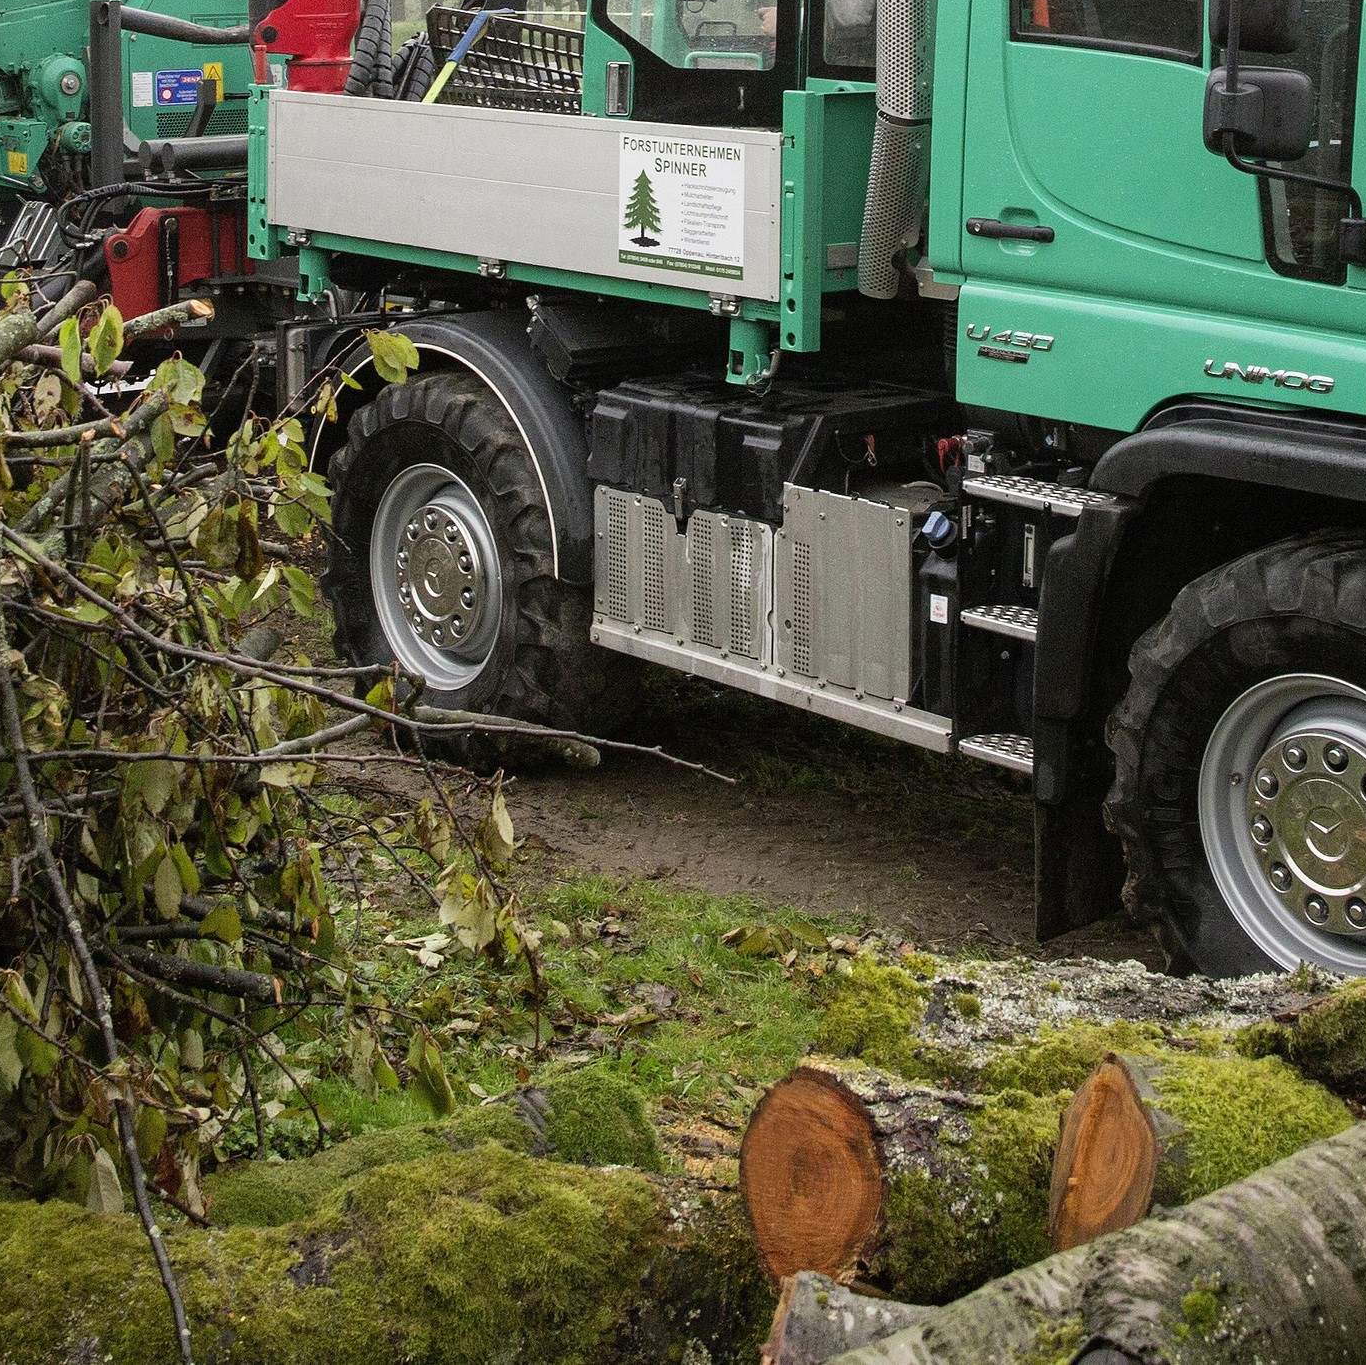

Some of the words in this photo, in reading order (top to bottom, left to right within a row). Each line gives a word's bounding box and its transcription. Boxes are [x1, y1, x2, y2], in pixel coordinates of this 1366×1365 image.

[622, 136, 741, 161] FORSTUNTERNEHMEN
[655, 157, 707, 177] SPINNER
[966, 323, 991, 341] U
[991, 329, 1055, 352] 430
[1203, 359, 1335, 394] UNIMOG
